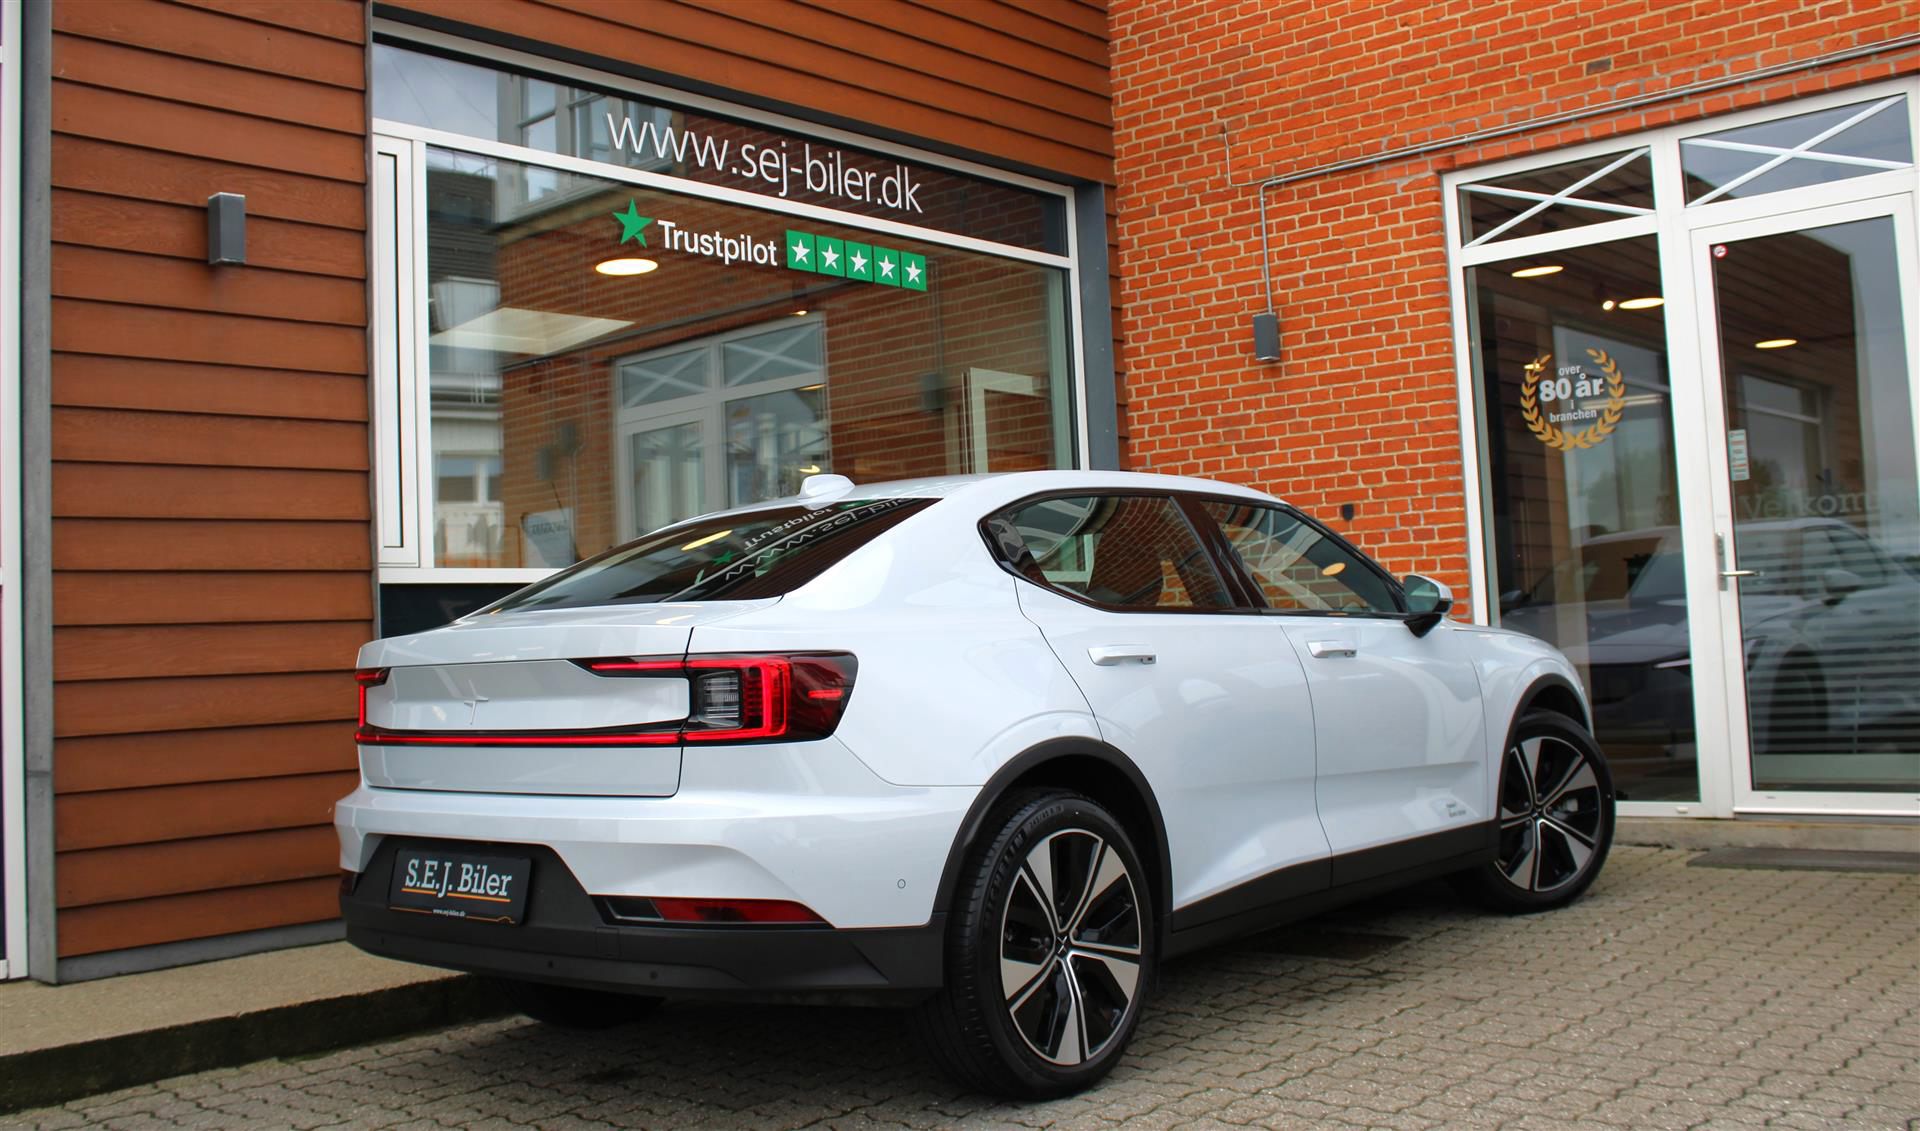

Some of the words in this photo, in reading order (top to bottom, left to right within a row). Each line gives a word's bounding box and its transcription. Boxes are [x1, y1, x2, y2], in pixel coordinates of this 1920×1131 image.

[606, 111, 924, 214] www.sej-biler.dk
[657, 219, 778, 267] Trustpilot
[1540, 378, 1572, 402] 80
[1575, 373, 1603, 398] år
[1558, 365, 1581, 377] over
[1549, 409, 1598, 423] branchen
[404, 858, 454, 898] S.E.J.
[457, 863, 513, 897] Biler
